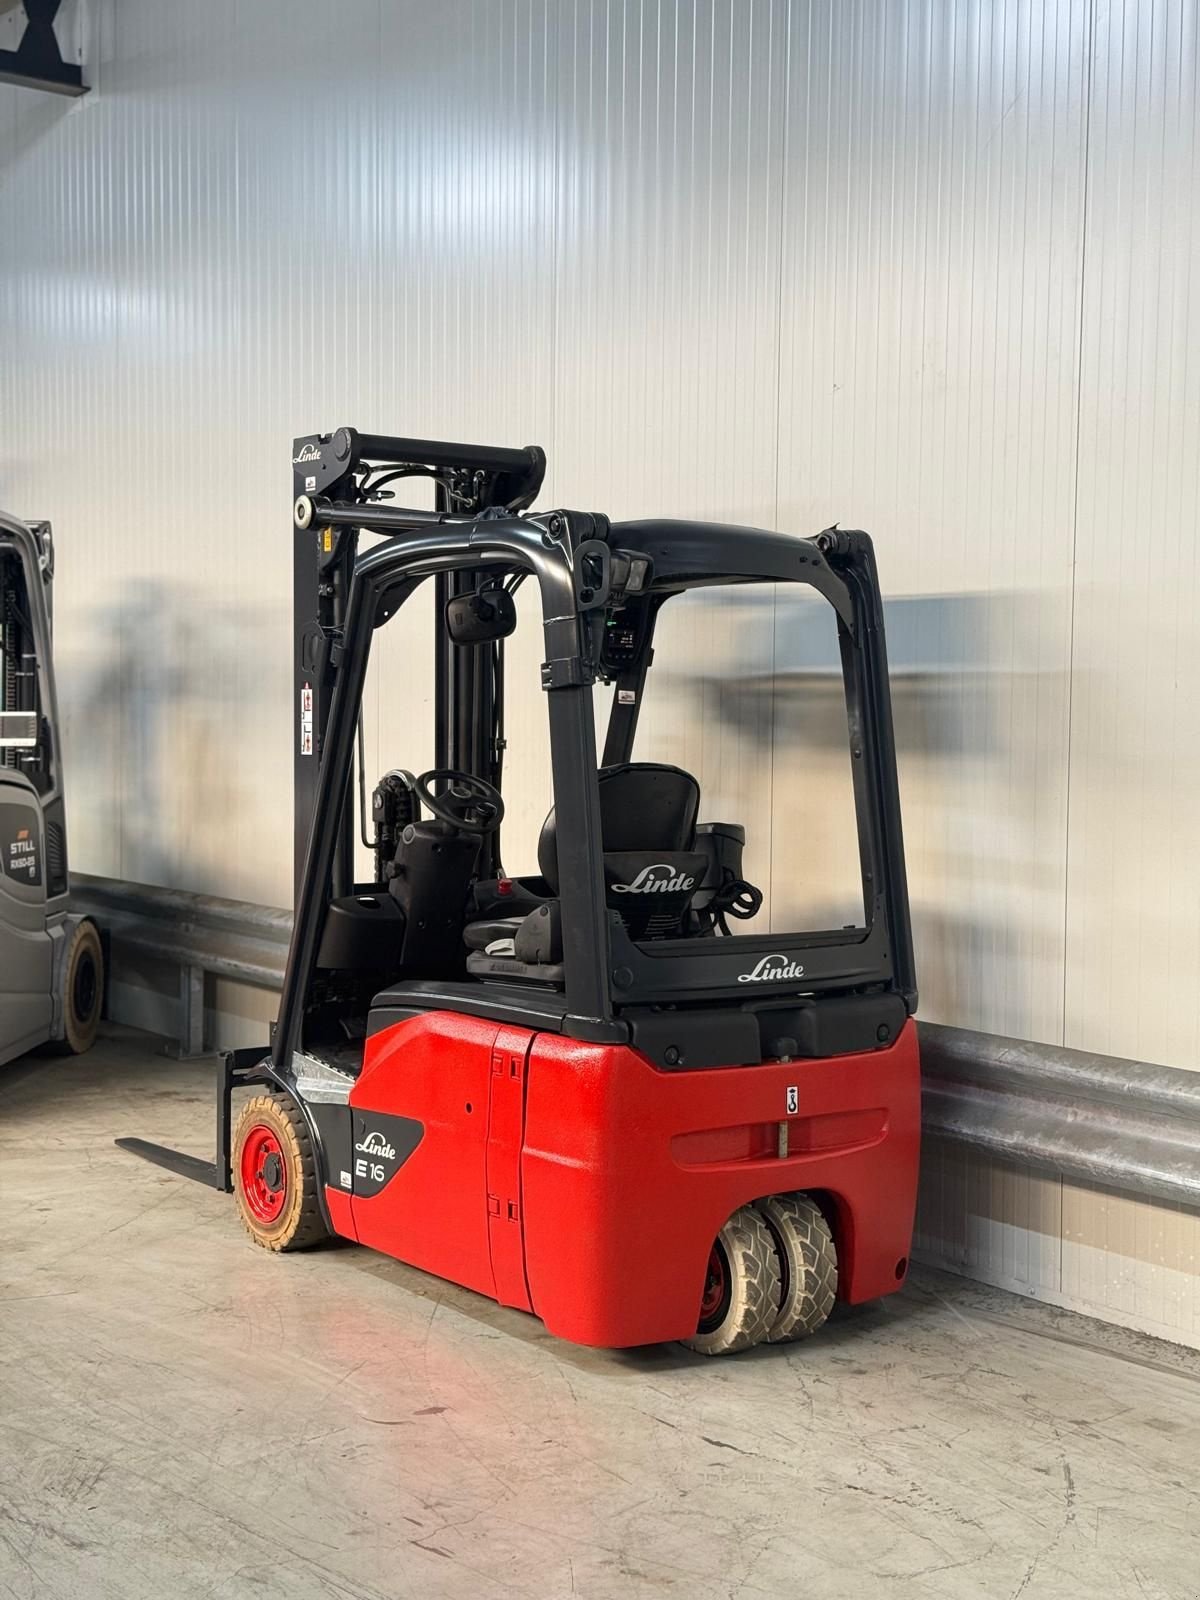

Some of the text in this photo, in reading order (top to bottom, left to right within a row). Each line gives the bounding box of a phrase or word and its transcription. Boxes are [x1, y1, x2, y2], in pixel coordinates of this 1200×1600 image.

[292, 444, 322, 464] Linde
[10, 840, 35, 854] STILL
[611, 864, 695, 893] Linde
[737, 954, 805, 983] Linde
[355, 1132, 396, 1160] Linde
[355, 1158, 385, 1182] E 16
